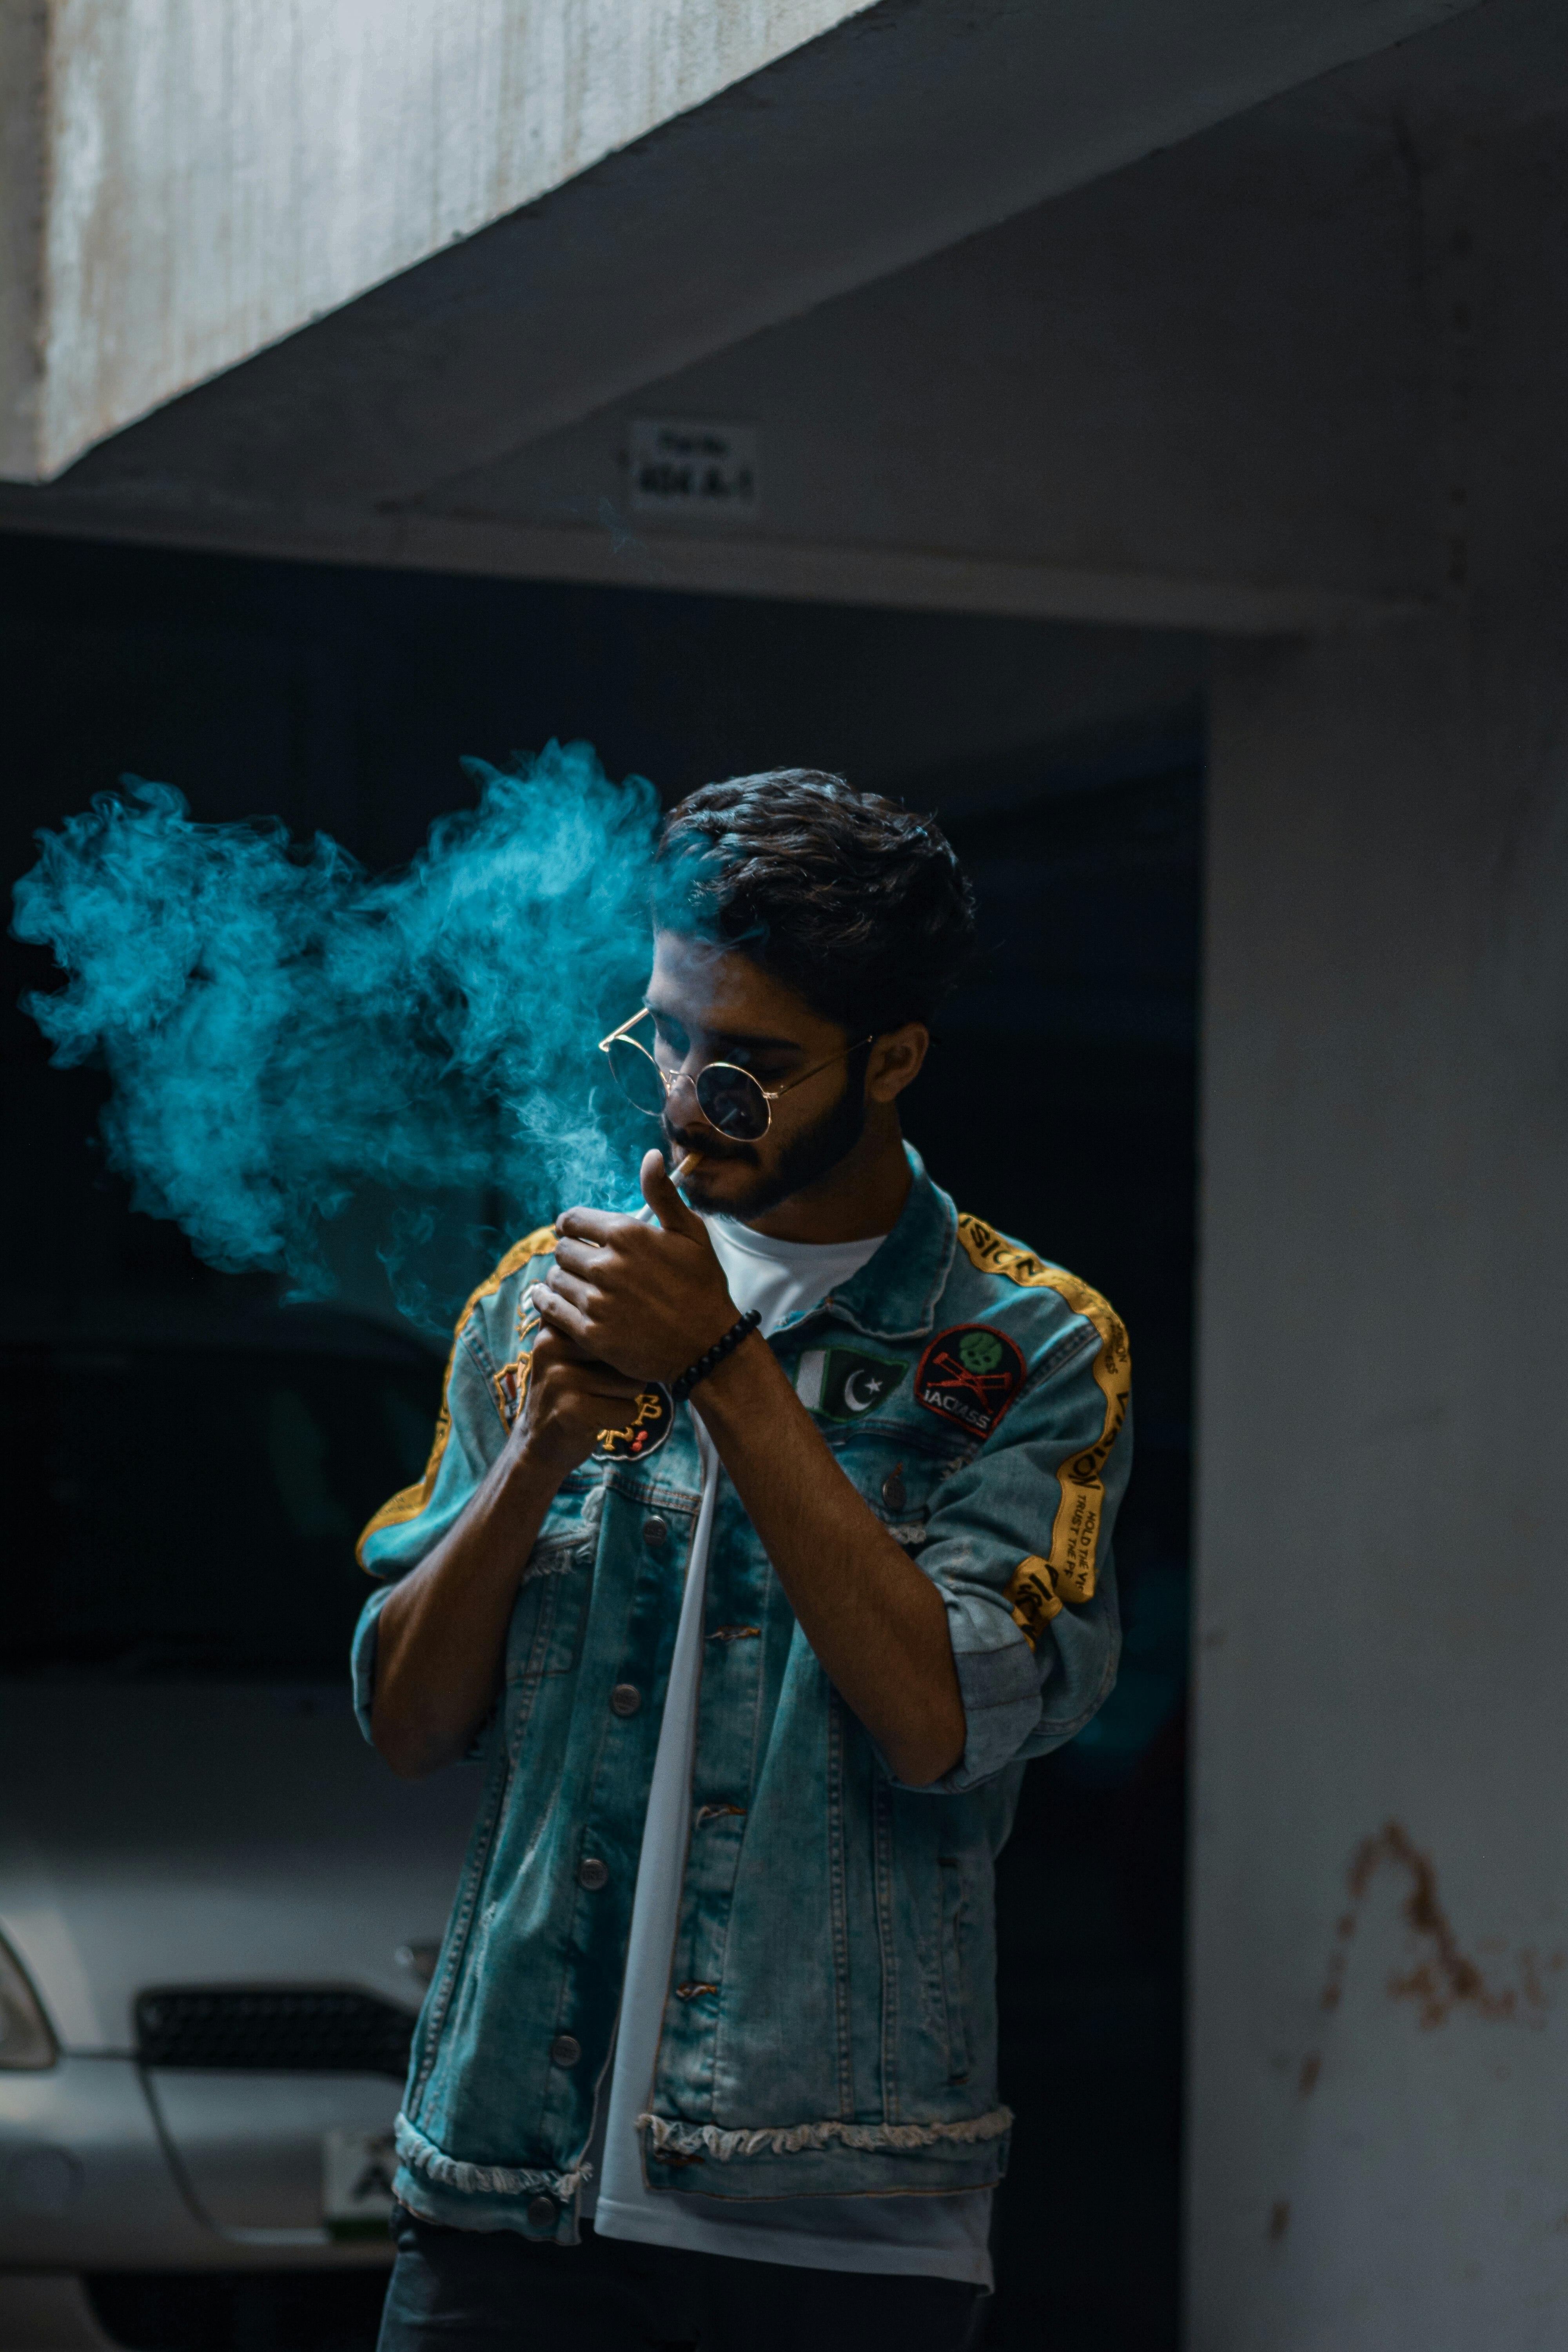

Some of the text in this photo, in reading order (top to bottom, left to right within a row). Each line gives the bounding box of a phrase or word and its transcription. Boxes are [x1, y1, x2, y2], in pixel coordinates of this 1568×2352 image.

[1071, 1495, 1087, 1535] TRUST
[1080, 1511, 1096, 1546] HOLD
[1067, 1539, 1077, 1560] THE
[1078, 1549, 1089, 1569] THE
